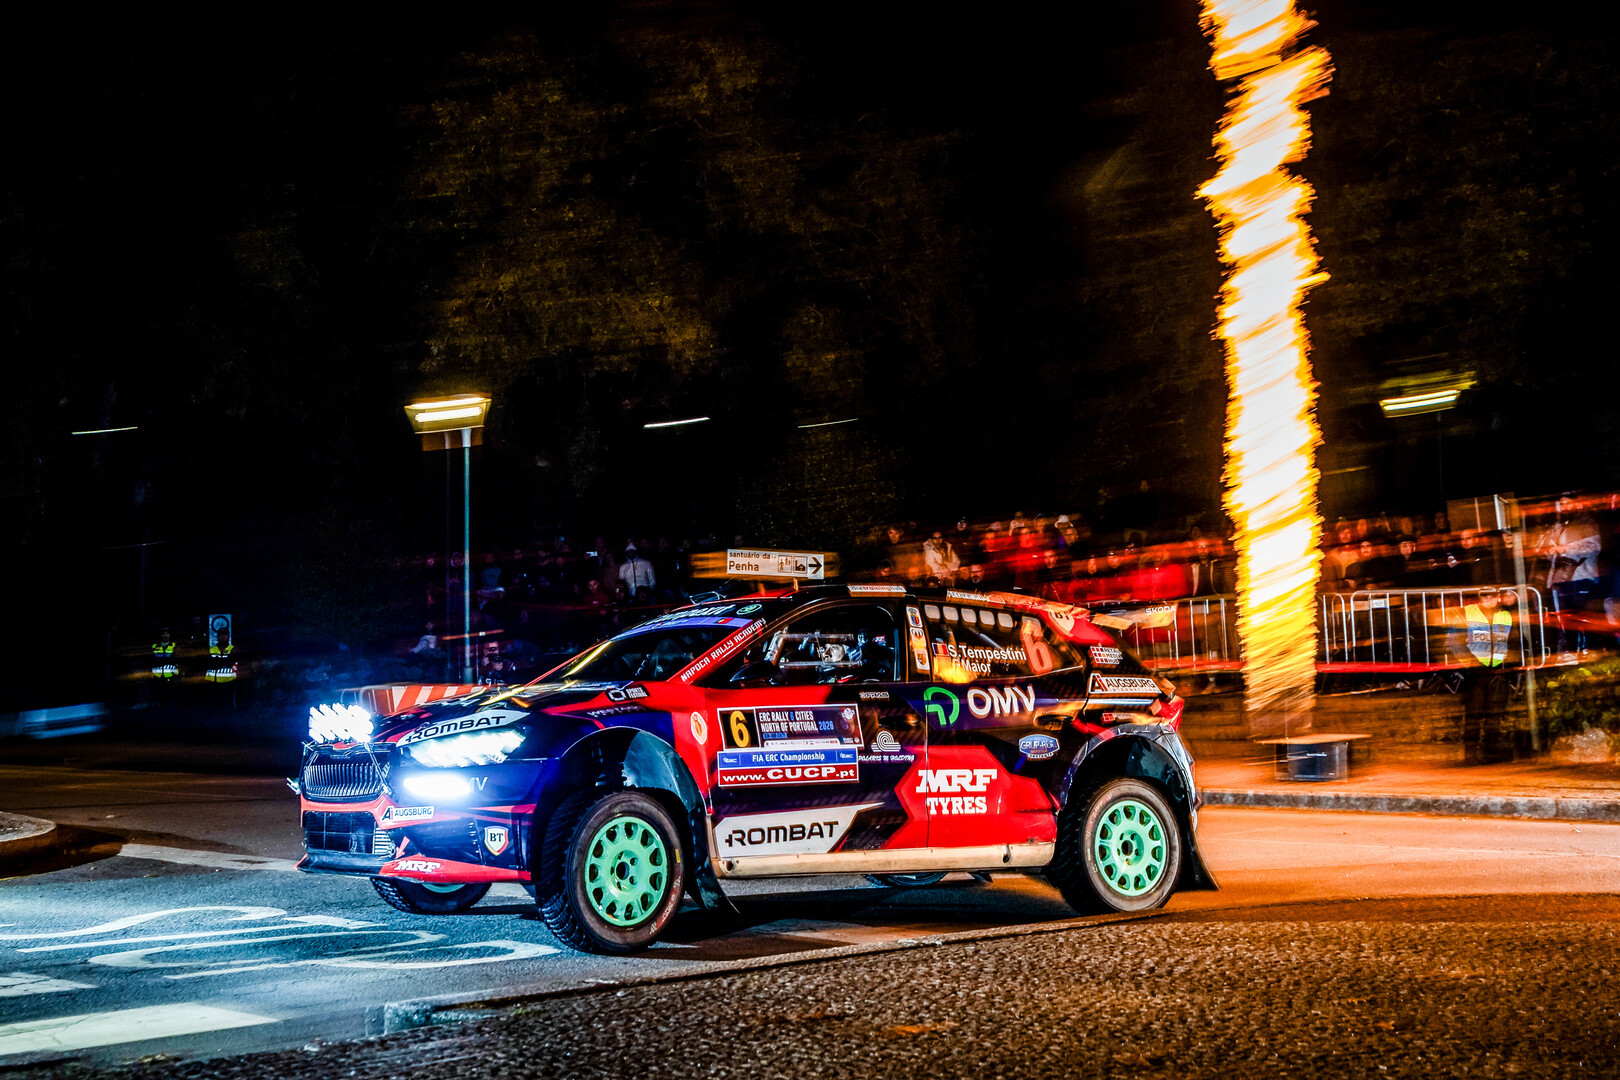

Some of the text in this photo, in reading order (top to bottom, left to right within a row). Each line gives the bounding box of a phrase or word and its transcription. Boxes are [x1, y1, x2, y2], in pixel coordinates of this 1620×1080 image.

[728, 560, 759, 572] Penha
[680, 617, 767, 682] NAPOCA RALLY ACADEMY
[1020, 615, 1053, 675] 6
[1105, 678, 1156, 688] AUGSBURG
[967, 686, 1035, 715] OMV
[759, 711, 814, 722] ERC RALLY 6 CITIES
[405, 716, 506, 742] ROMBAT
[730, 710, 750, 748] 6
[760, 722, 781, 732] NORTH
[780, 722, 789, 731] OF
[789, 721, 819, 731] PORTUGAL
[752, 751, 825, 763] FIA ERC Championship
[722, 766, 855, 782] www.CUCP.pt
[916, 769, 997, 793] MRF
[394, 807, 432, 817] AUGSBURG
[926, 796, 987, 815] TYRES
[489, 832, 504, 843] BT
[725, 821, 839, 848] ROMBAT
[394, 859, 441, 875] MRF
